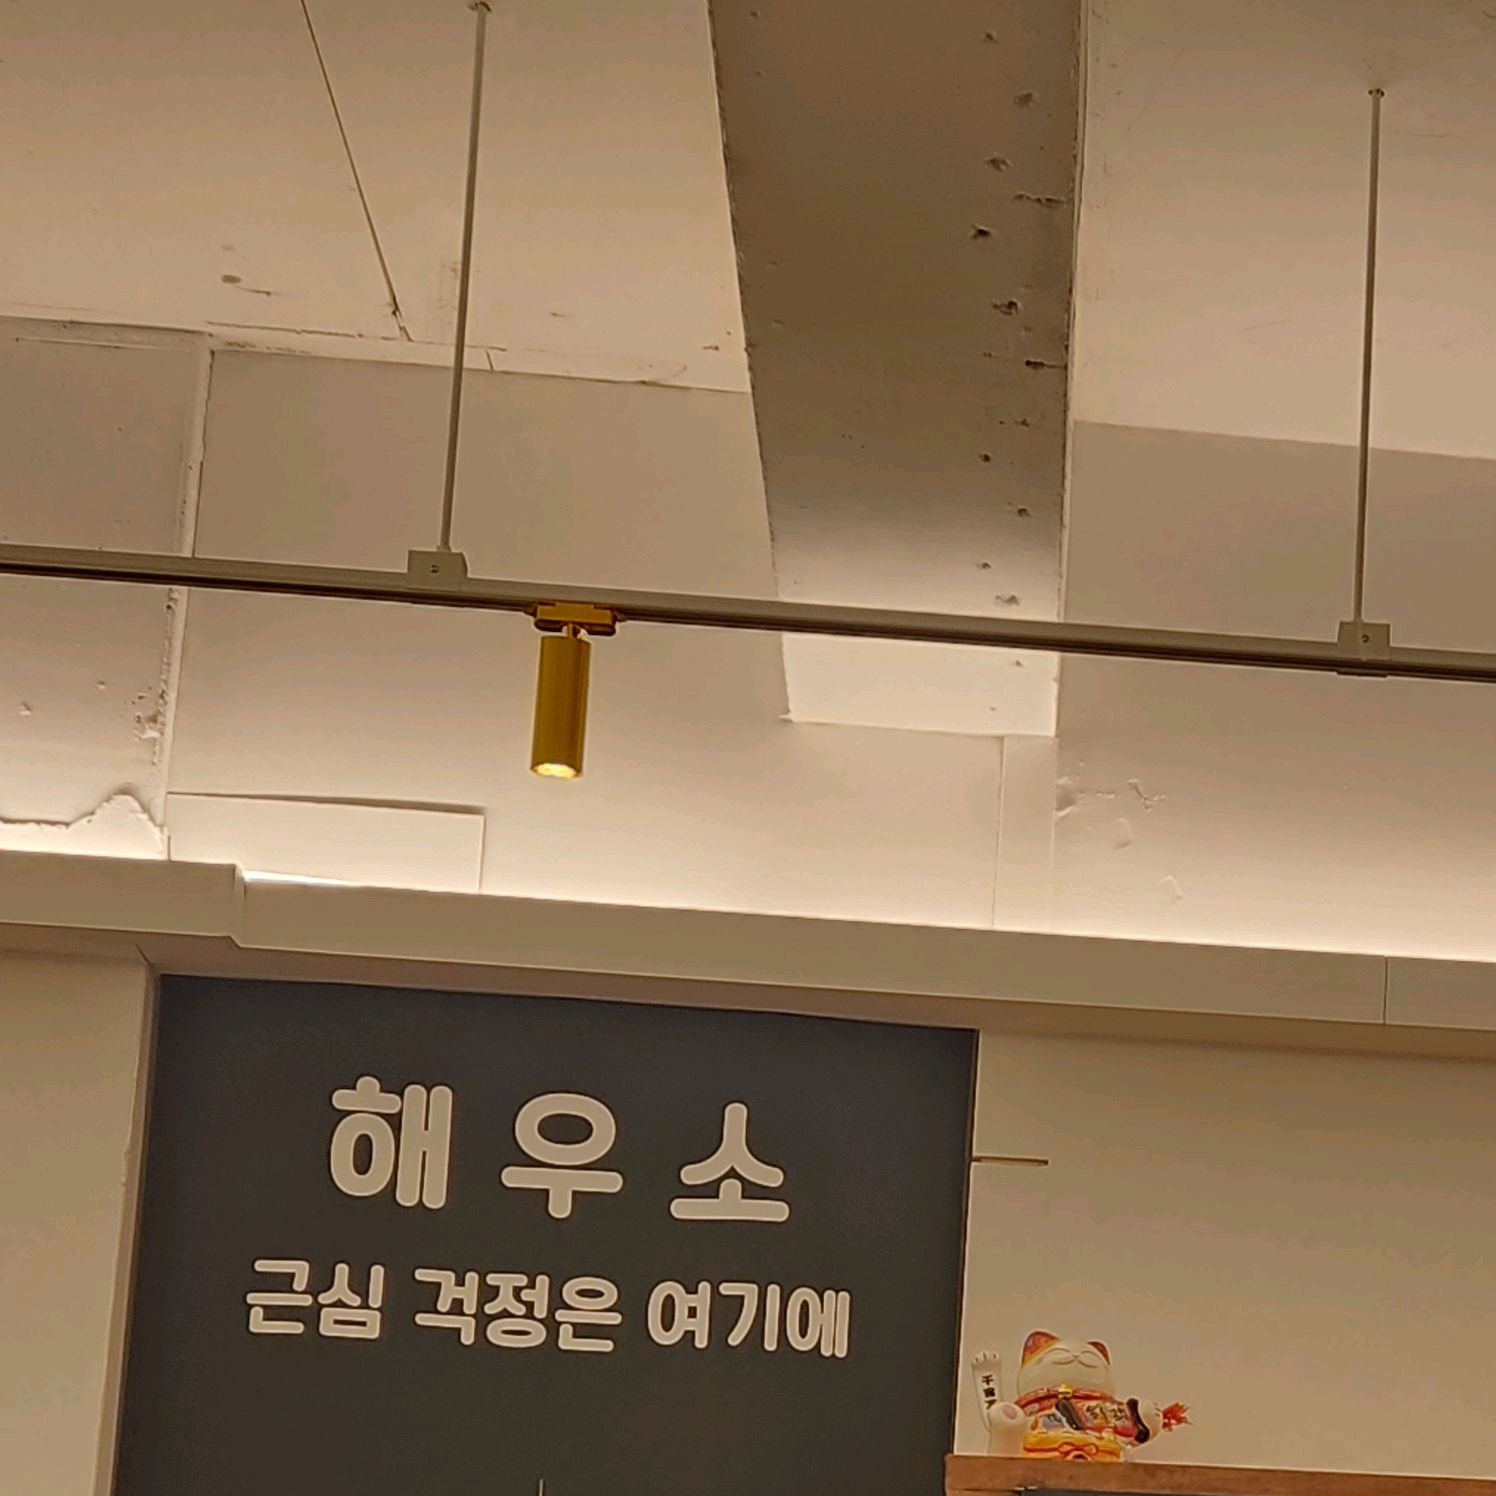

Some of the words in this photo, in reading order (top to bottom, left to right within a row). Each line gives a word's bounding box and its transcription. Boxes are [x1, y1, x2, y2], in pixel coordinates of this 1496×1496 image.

[246, 1259, 385, 1340] 근심
[414, 1268, 623, 1353] 걱정은
[647, 1281, 850, 1358] 여기에
